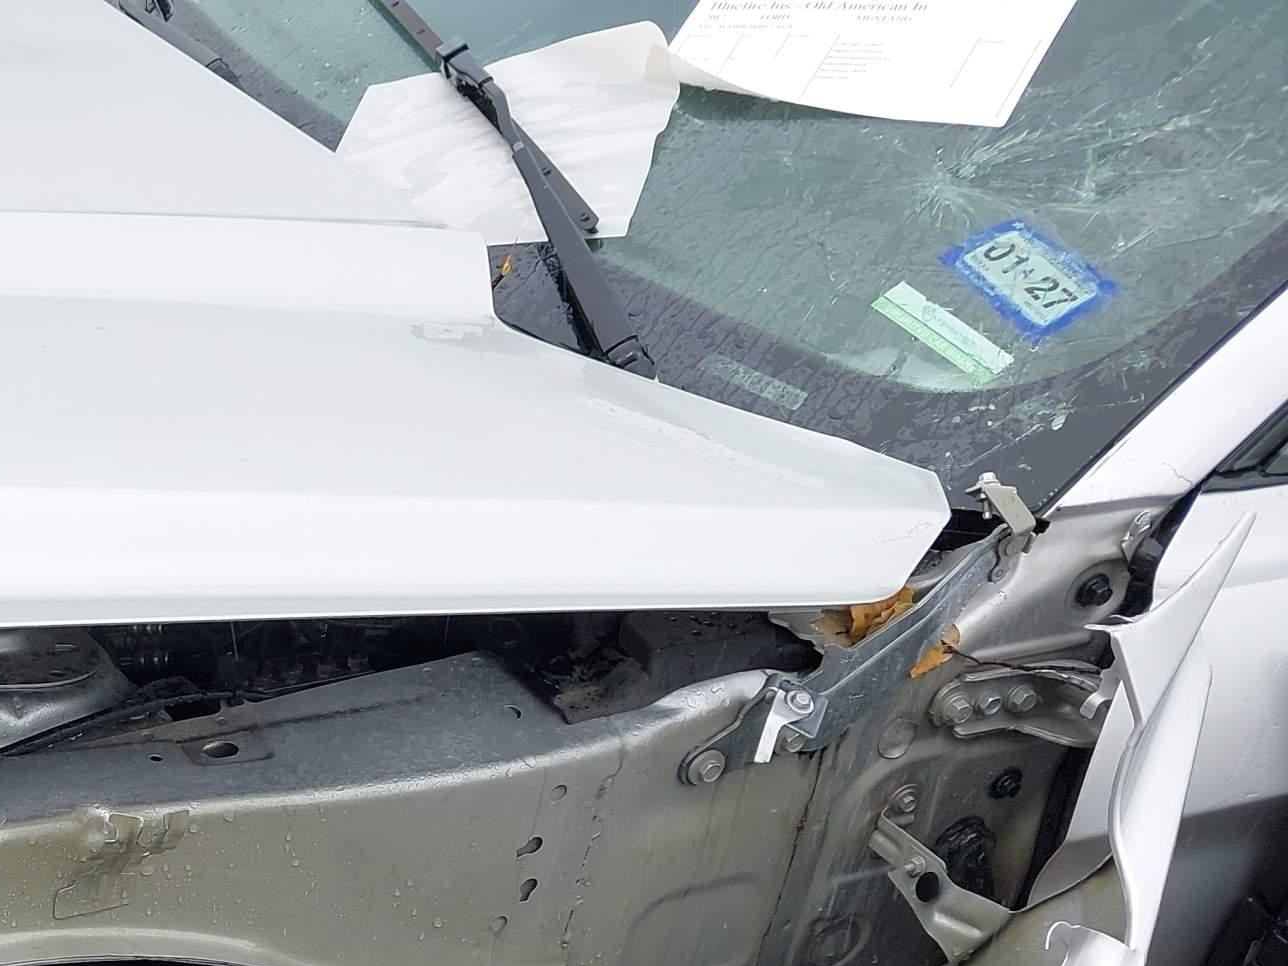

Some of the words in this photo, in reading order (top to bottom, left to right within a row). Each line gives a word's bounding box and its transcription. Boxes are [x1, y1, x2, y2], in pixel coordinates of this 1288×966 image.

[805, 1, 833, 11] Old
[836, 1, 908, 12] American
[1024, 276, 1079, 309] 27
